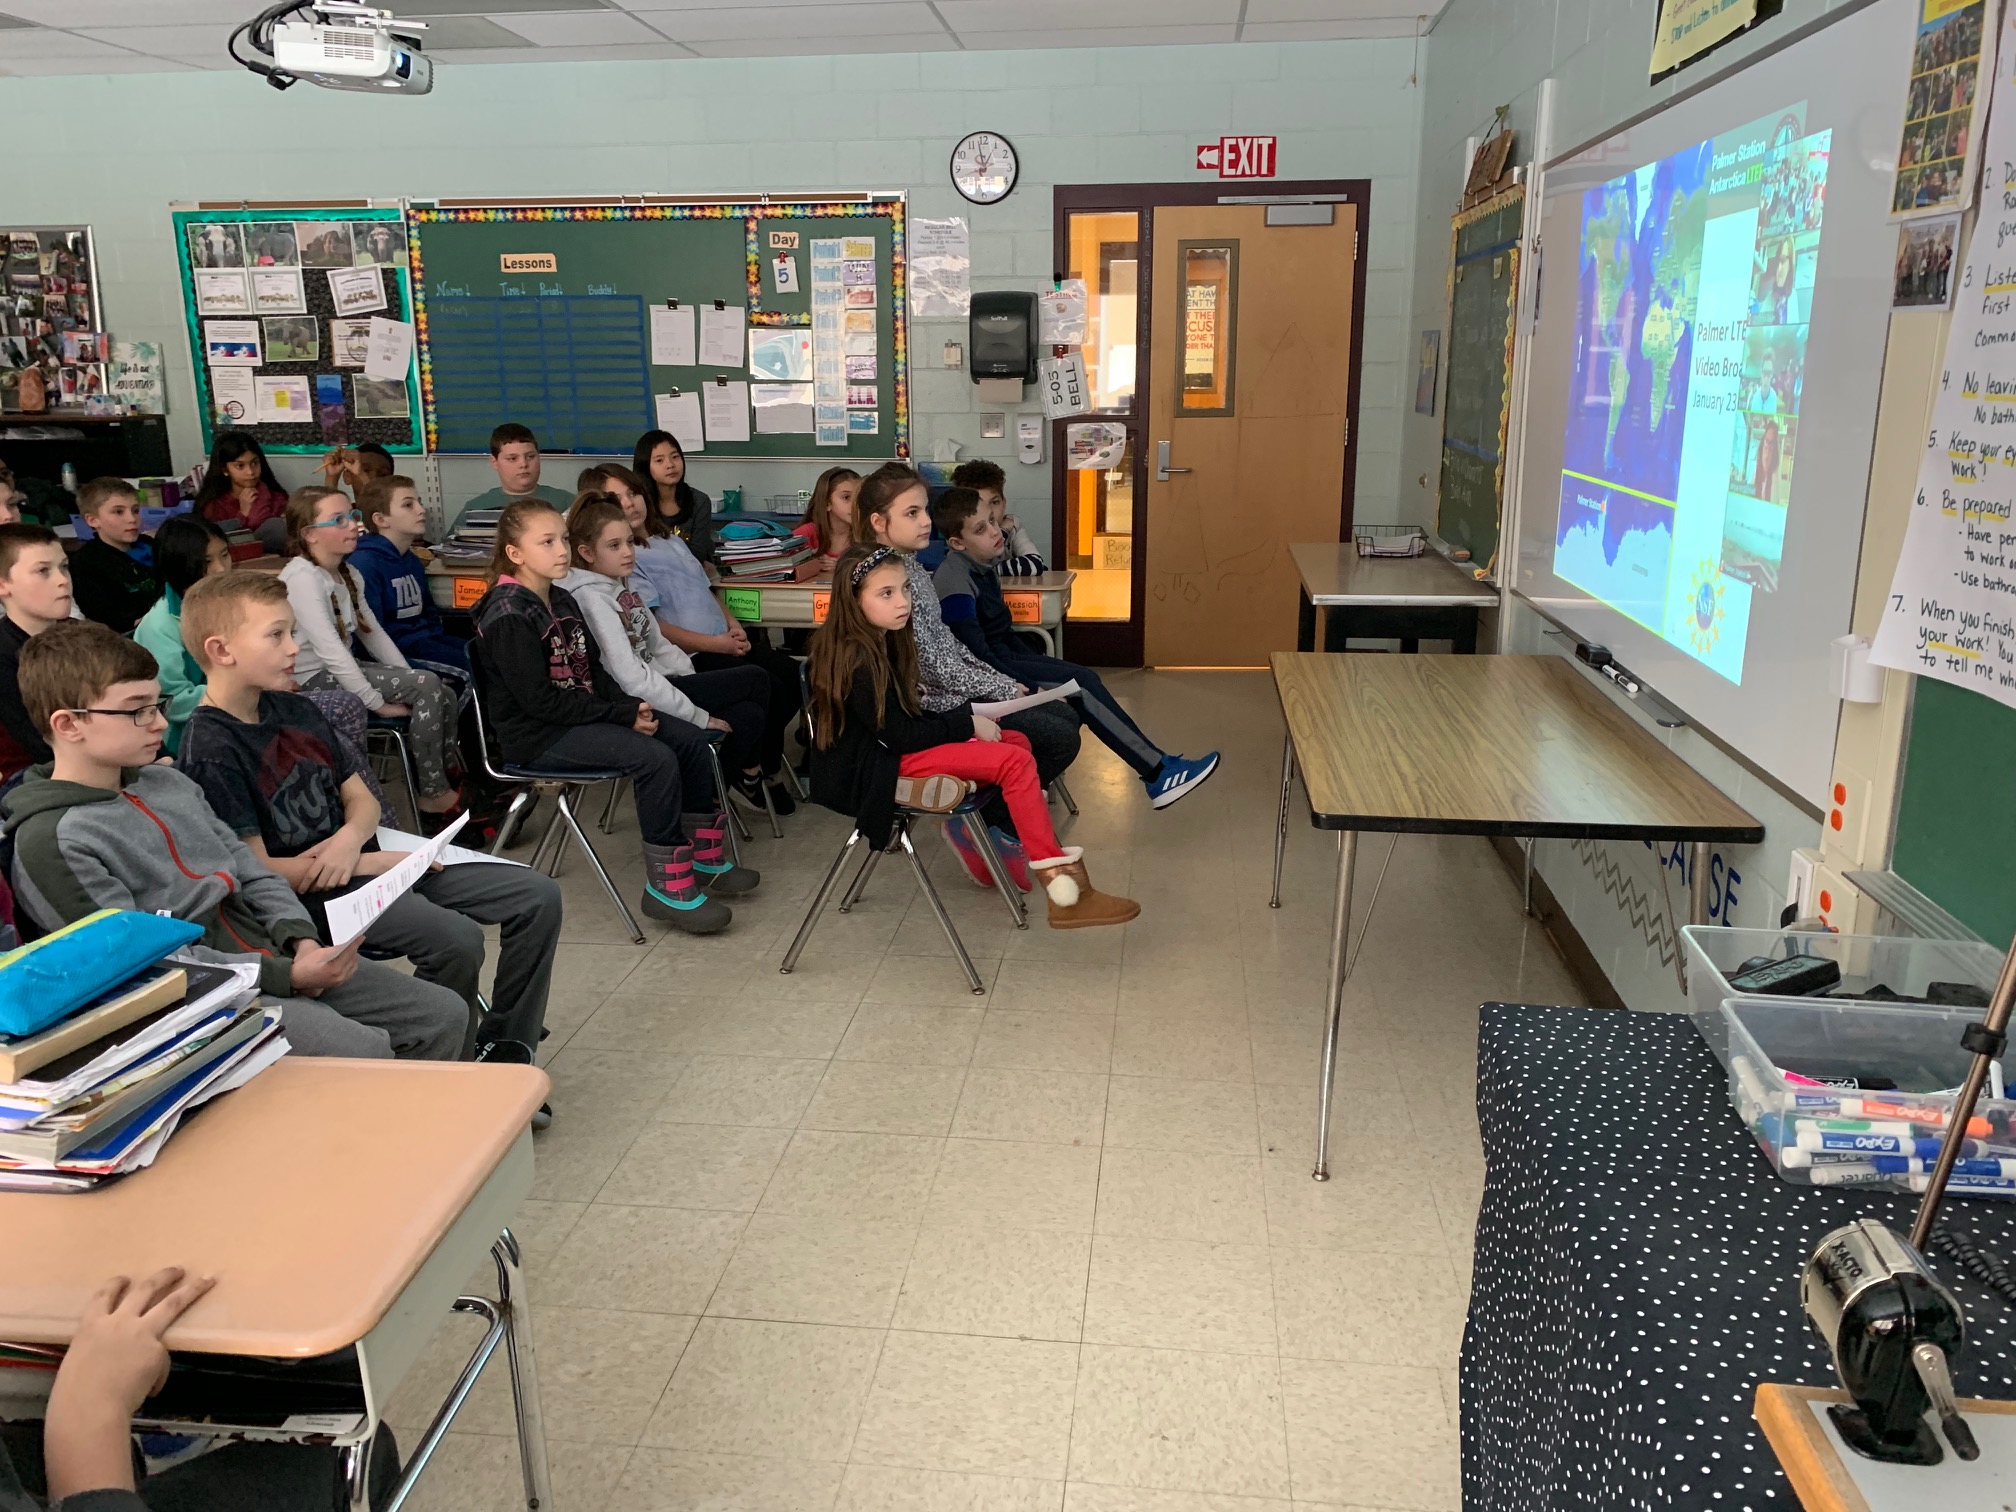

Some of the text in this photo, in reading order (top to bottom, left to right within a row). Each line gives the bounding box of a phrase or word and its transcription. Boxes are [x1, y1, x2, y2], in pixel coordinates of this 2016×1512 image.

[968, 141, 975, 149] 11
[980, 136, 989, 145] 12
[958, 151, 966, 159] 10
[1003, 150, 1008, 158] 2
[1223, 138, 1273, 175] EXIT
[1712, 140, 1766, 171] Palmer Station
[955, 165, 961, 173] 9
[1007, 163, 1012, 172] 3
[1709, 171, 1746, 195] Antarctica
[772, 234, 796, 247] Day
[504, 257, 552, 269] Lessons
[778, 268, 789, 283] 5
[1697, 321, 1729, 341] Palmer
[1695, 356, 1720, 377] Video
[1048, 370, 1063, 405] 5-05
[1066, 362, 1081, 406] BELL
[1963, 371, 1979, 394] No
[1693, 390, 1737, 415] January 23
[1974, 405, 1986, 424] No
[1949, 430, 1976, 458] Keep
[1978, 442, 2001, 464] your
[1942, 489, 1957, 510] Be
[1963, 497, 2011, 525] prepared
[1964, 545, 1974, 561] to
[458, 585, 484, 595] James
[728, 597, 757, 606] Anthony
[1697, 592, 1713, 616] NSF
[1892, 595, 1906, 613] 7.
[1921, 598, 1954, 622] When
[1957, 611, 1980, 635] you
[1916, 626, 1948, 650] your
[1919, 649, 1936, 667] to
[1946, 656, 1968, 673] tell
[1975, 662, 1993, 680] me
[1896, 1106, 1939, 1120] EXPO
[1855, 1136, 1896, 1150] EXPO
